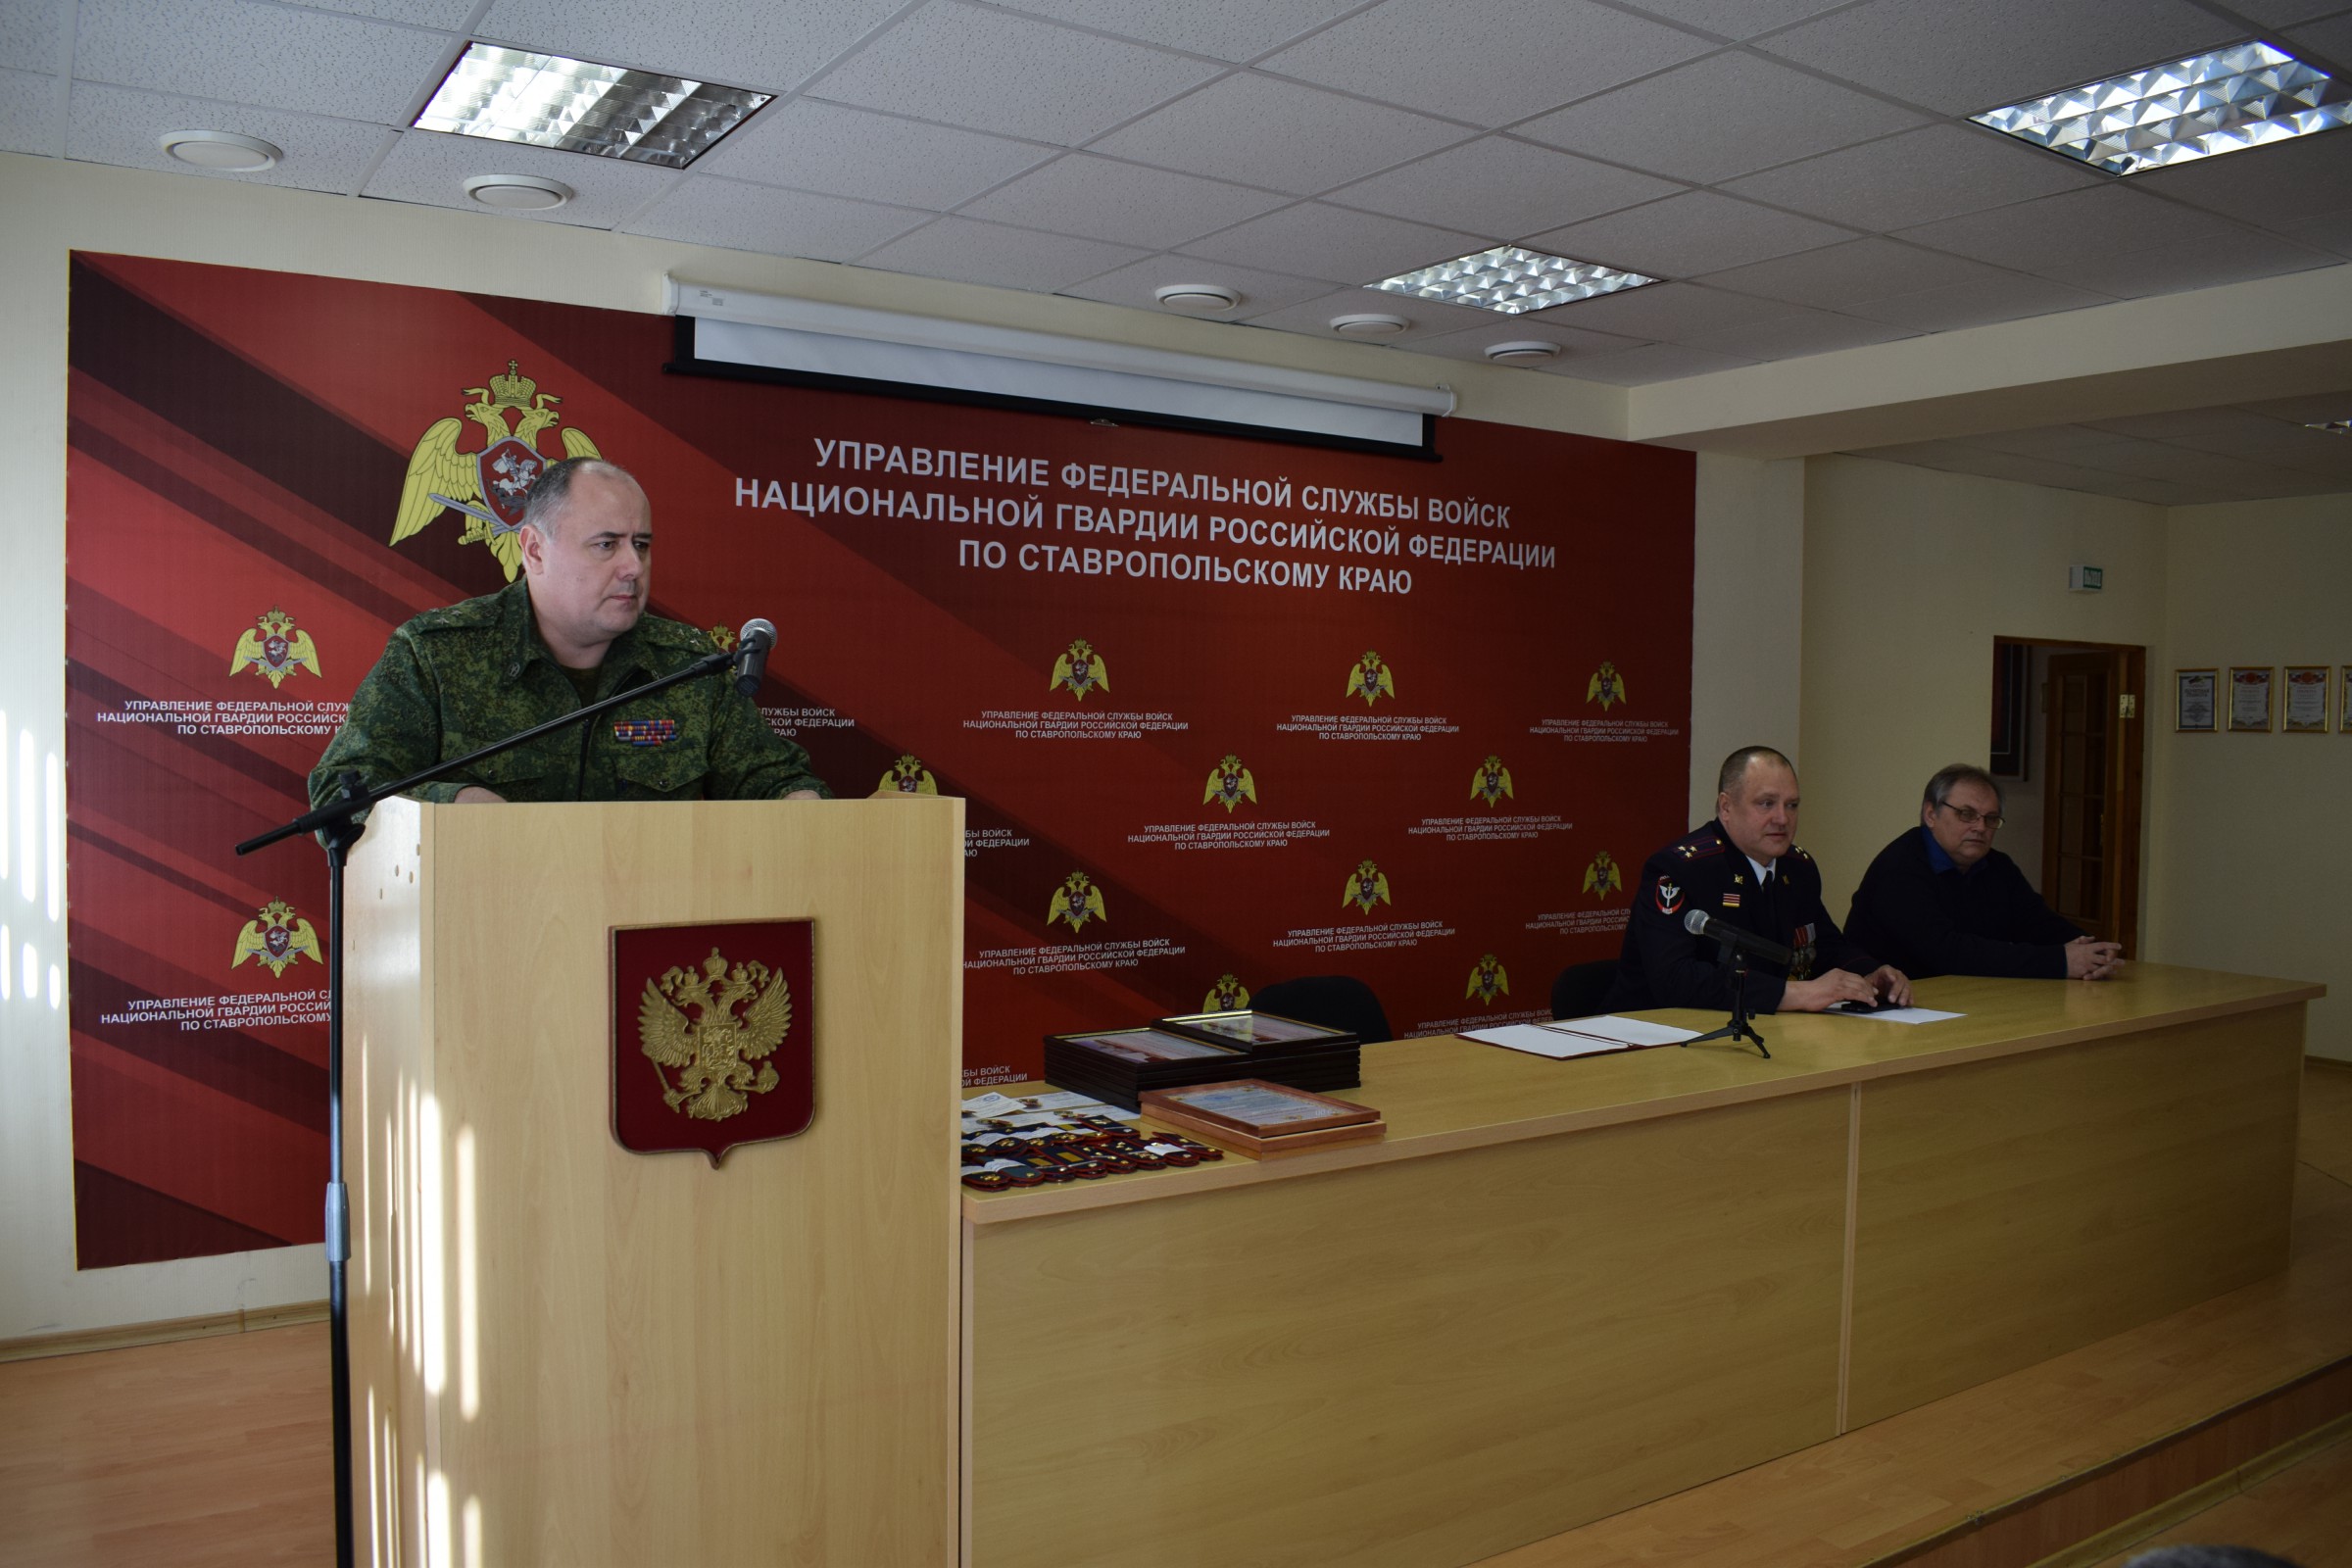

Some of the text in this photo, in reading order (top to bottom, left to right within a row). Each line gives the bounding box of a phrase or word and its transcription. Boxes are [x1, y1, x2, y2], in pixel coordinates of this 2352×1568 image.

[813, 438, 1510, 529] УПРАВЛЕНИЕ ФЕДЕРАЛЬНОЙ СЛУЖБЫ ВОЙСК
[735, 477, 1555, 570] НАЦИОНАЛЬНОЙ ГВАРДИИ РОССИЙСКОЙ ФЕДЕРАЦИИ
[959, 539, 1412, 594] ПО СТАВРОПОЛЬСКОМУ КРАЮ
[124, 700, 350, 712] УПРАВЛЕНИЕ ФЕДЕРАЛЬНОЙ СЛУЖ
[758, 707, 835, 717] ЛУЖБЫ ВОЙСК
[97, 711, 347, 724] НАЦИОНАЛЬНОЙ ГВАРДИИ РОССИЙСК
[981, 710, 1173, 721] УПРАВЛЕНИЕ ФЕДЕРАЛЬНОЙ СЛУЖБЫ ВОЙСК
[1292, 714, 1338, 723] УПРАВЛЕНИЕ
[1340, 715, 1392, 724] ФЕДЕРАЛЬНОЙ
[1425, 715, 1446, 724] ВОЙСК
[794, 718, 855, 728] ФЕДЕРАЦИИ
[963, 719, 1189, 731] НАЦИОНАЛЬНОЙ ГВАРДИИ РОССИЙСКОЙ ФЕДЕРАЦИИ
[1276, 723, 1337, 732] НАЦИОНАЛЬНОЙ
[1372, 723, 1418, 732] РОССИЙСКОЙ
[177, 724, 196, 735] ПО
[200, 725, 331, 735] СТАВРОПОЛЬСКОМУ
[773, 728, 797, 737] РАЮ
[1030, 730, 1116, 739] СТАВРОПОЛЬСКОМУ
[1331, 732, 1400, 741] СТАВРОПОЛЬСКОМУ
[1145, 820, 1316, 833] УПРАВЛЕНИЕ ФЕДЕРАЛЬНОЙ СЛУЖБЫ ВОЙСК
[1421, 817, 1463, 826] УПРАВЛЕНИЕ
[1465, 815, 1511, 825] ФЕДЕРАЛЬНОЙ
[982, 828, 1012, 838] ВОЙСК
[1408, 825, 1463, 835] НАЦИОНАЛЬНОЙ
[1494, 823, 1535, 832] РОССИЙСКОЙ
[1128, 829, 1330, 844] НАЦИОНАЛЬНОЙ ГВАРДИИ РОССИЙСКОЙ ФЕДЕРАЦИИ
[1457, 832, 1520, 841] СТАВРОПОЛЬСКОМУ
[975, 838, 1030, 848] ФЕДЕРАЦИИ
[1175, 842, 1187, 851] ПО
[1188, 840, 1265, 850] СТАВРОПОЛЬСКОМУ
[1288, 920, 1444, 938] УПРАВЛЕНИЕ ФЕДЕРАЛЬНОЙ СЛУЖБЫ ВОЙСК
[1273, 928, 1455, 948] НАЦИОНАЛЬНОЙ ГВАРДИИ РОССИЙСКОЙ ФЕДЕРАЦИИ
[979, 937, 1170, 958] УПРАВЛЕНИЕ ФЕДЕРАЛЬНОЙ СЛУЖБЫ ВОЙСК
[1327, 941, 1396, 952] СТАВРОПОЛЬСКОМУ
[1398, 939, 1418, 948] КРАЮ
[1037, 954, 1076, 965] ГВАРДИИ
[1078, 950, 1135, 962] РОССИЙСКОЙ
[1137, 946, 1186, 957] ФЕДЕРАЦИИ
[1013, 958, 1139, 975] ПО СТАВРОПОЛЬСКОМУ КРАЮ
[127, 997, 215, 1010] УПРАВЛЕНИЕ
[219, 990, 316, 1006] ФЕДЕРАЛЬНОЙ
[101, 999, 331, 1024] НАЦИОНАЛЬНОЙ ГВАРДИИ РОССИЙ
[181, 1020, 200, 1031] ПО
[980, 1064, 1010, 1076] ВОЙСК
[974, 1073, 1028, 1086] ФЕДЕРАЦИИ
